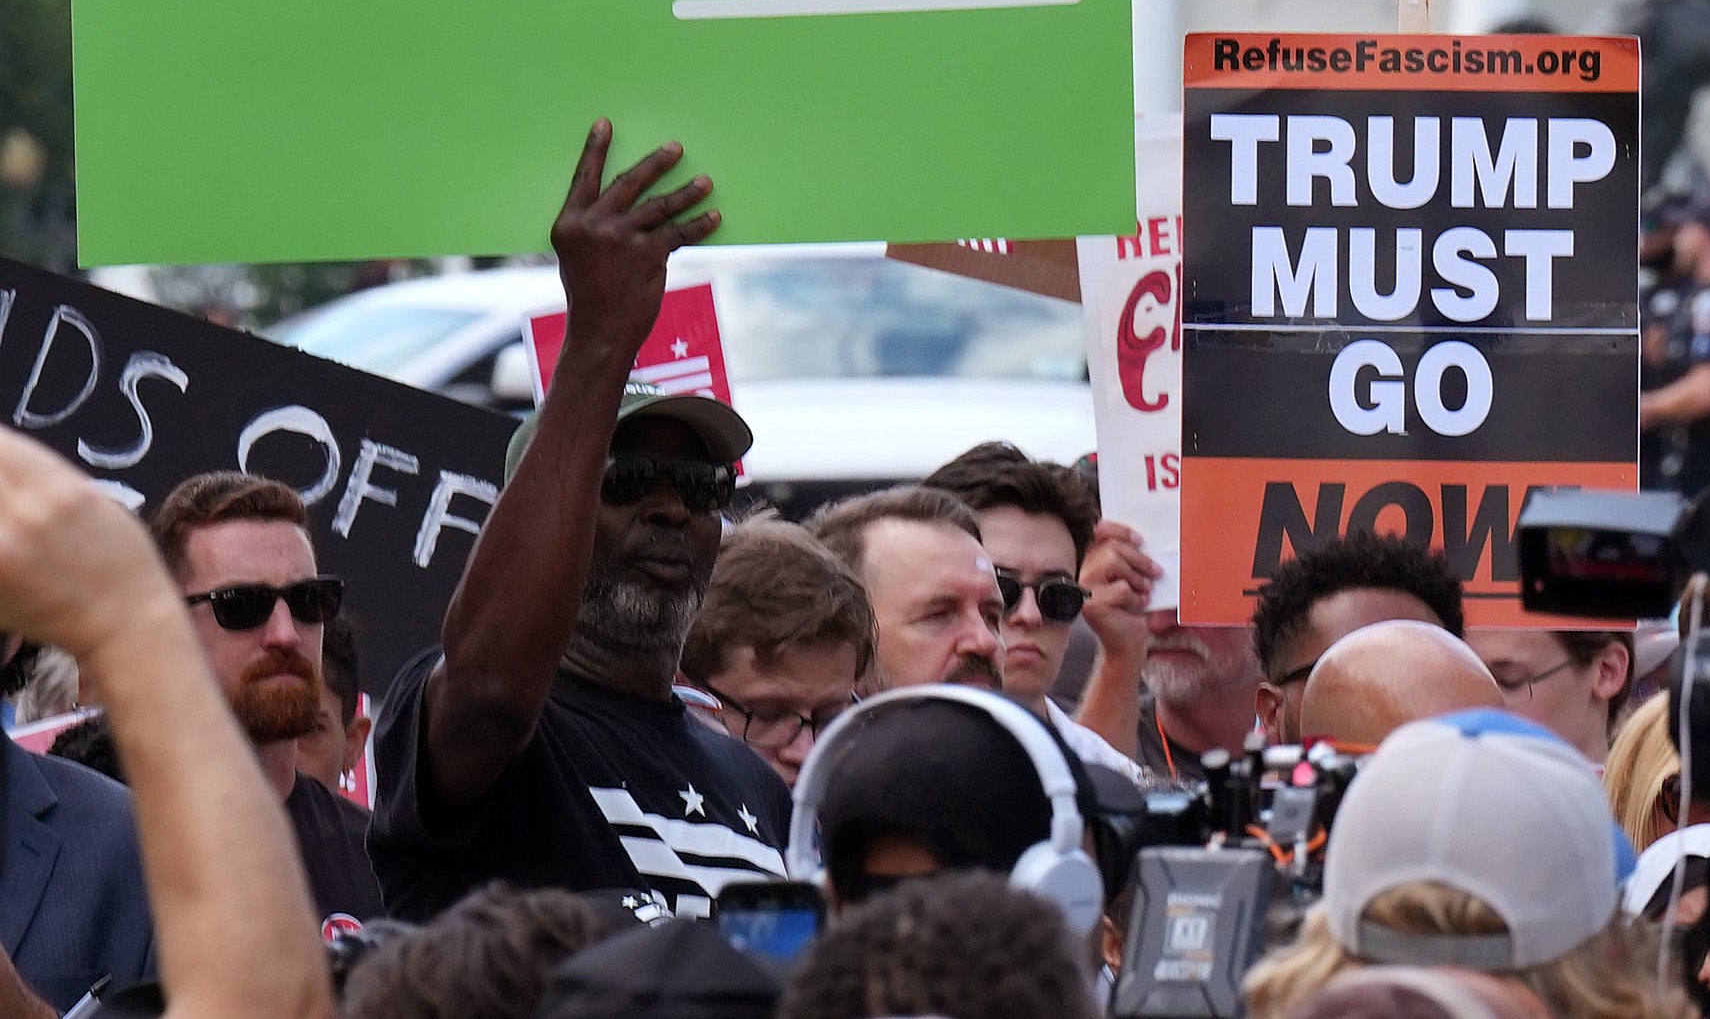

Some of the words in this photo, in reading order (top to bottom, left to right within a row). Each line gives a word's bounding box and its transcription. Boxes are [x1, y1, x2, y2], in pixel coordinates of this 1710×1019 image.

[1213, 39, 1601, 82] RefuseFascism.org
[1210, 113, 1617, 210] TRUMP
[1251, 225, 1574, 322] MUST
[1328, 338, 1494, 437] GO
[237, 404, 500, 568] OFF
